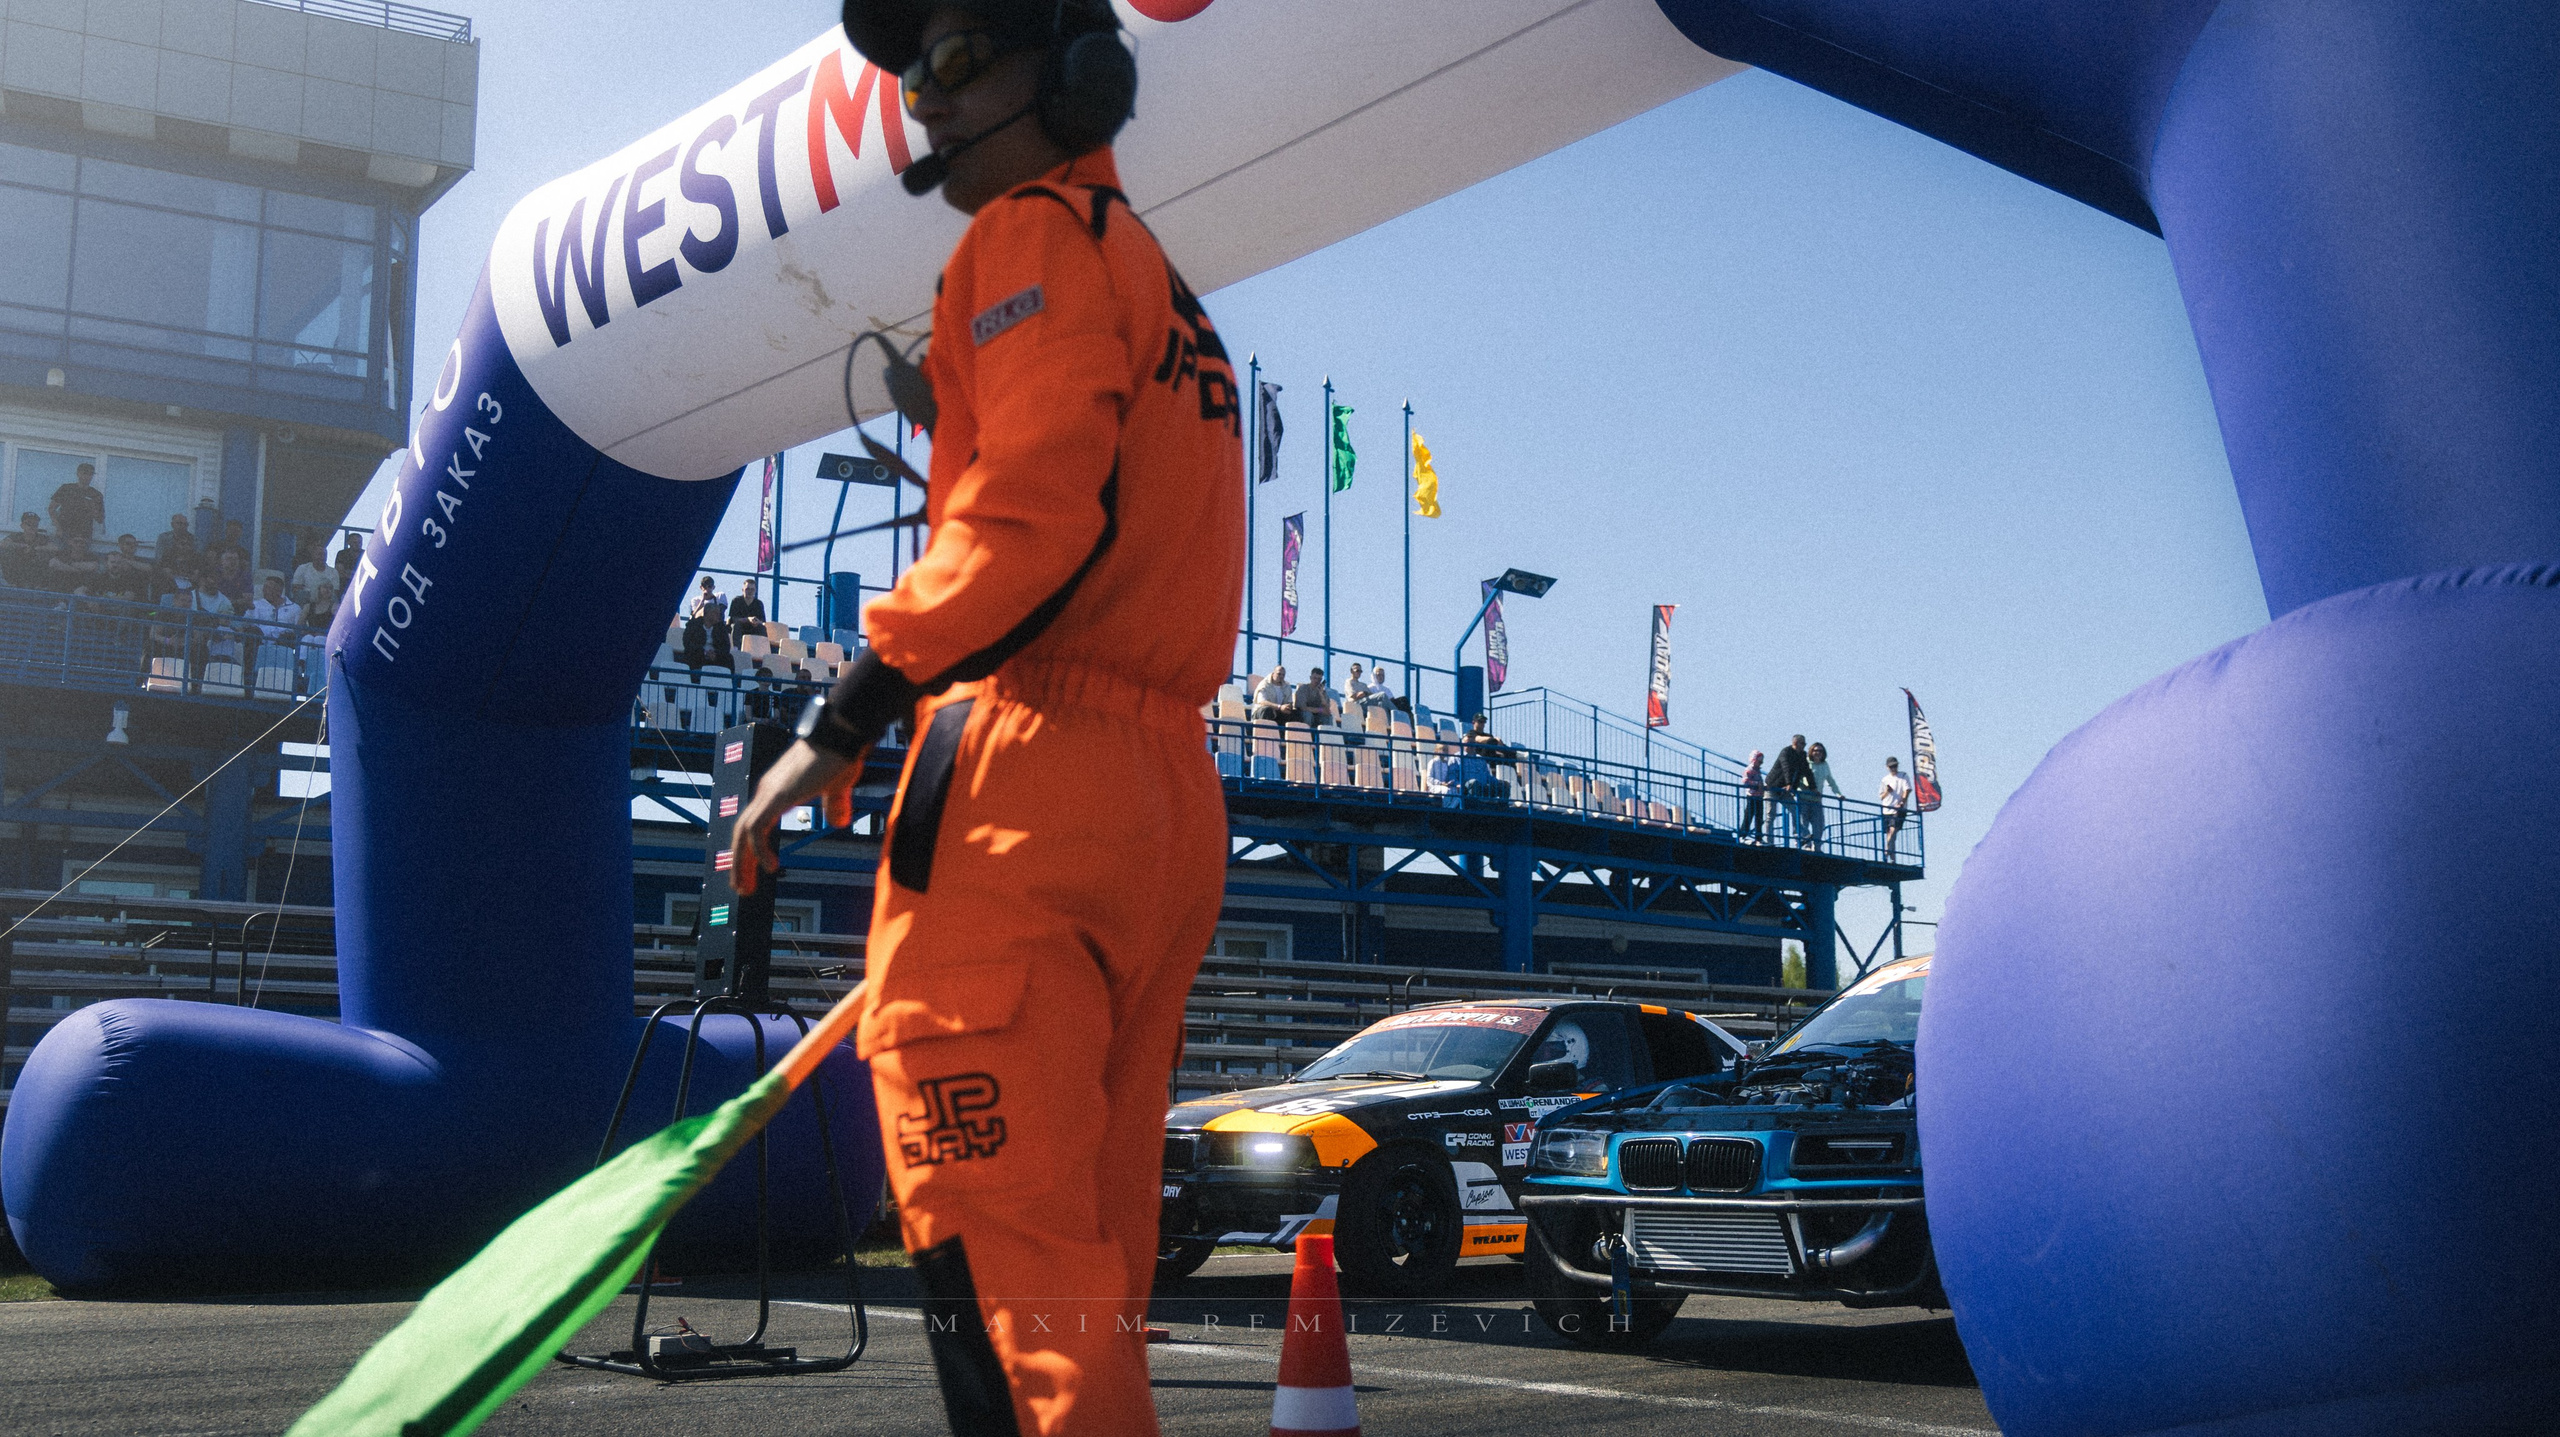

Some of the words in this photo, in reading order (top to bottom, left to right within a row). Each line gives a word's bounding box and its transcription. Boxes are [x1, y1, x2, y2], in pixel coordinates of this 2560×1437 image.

[372, 562, 434, 662] ПОД
[422, 391, 503, 549] ЗАКАЗ
[1163, 1184, 1182, 1198] DAY
